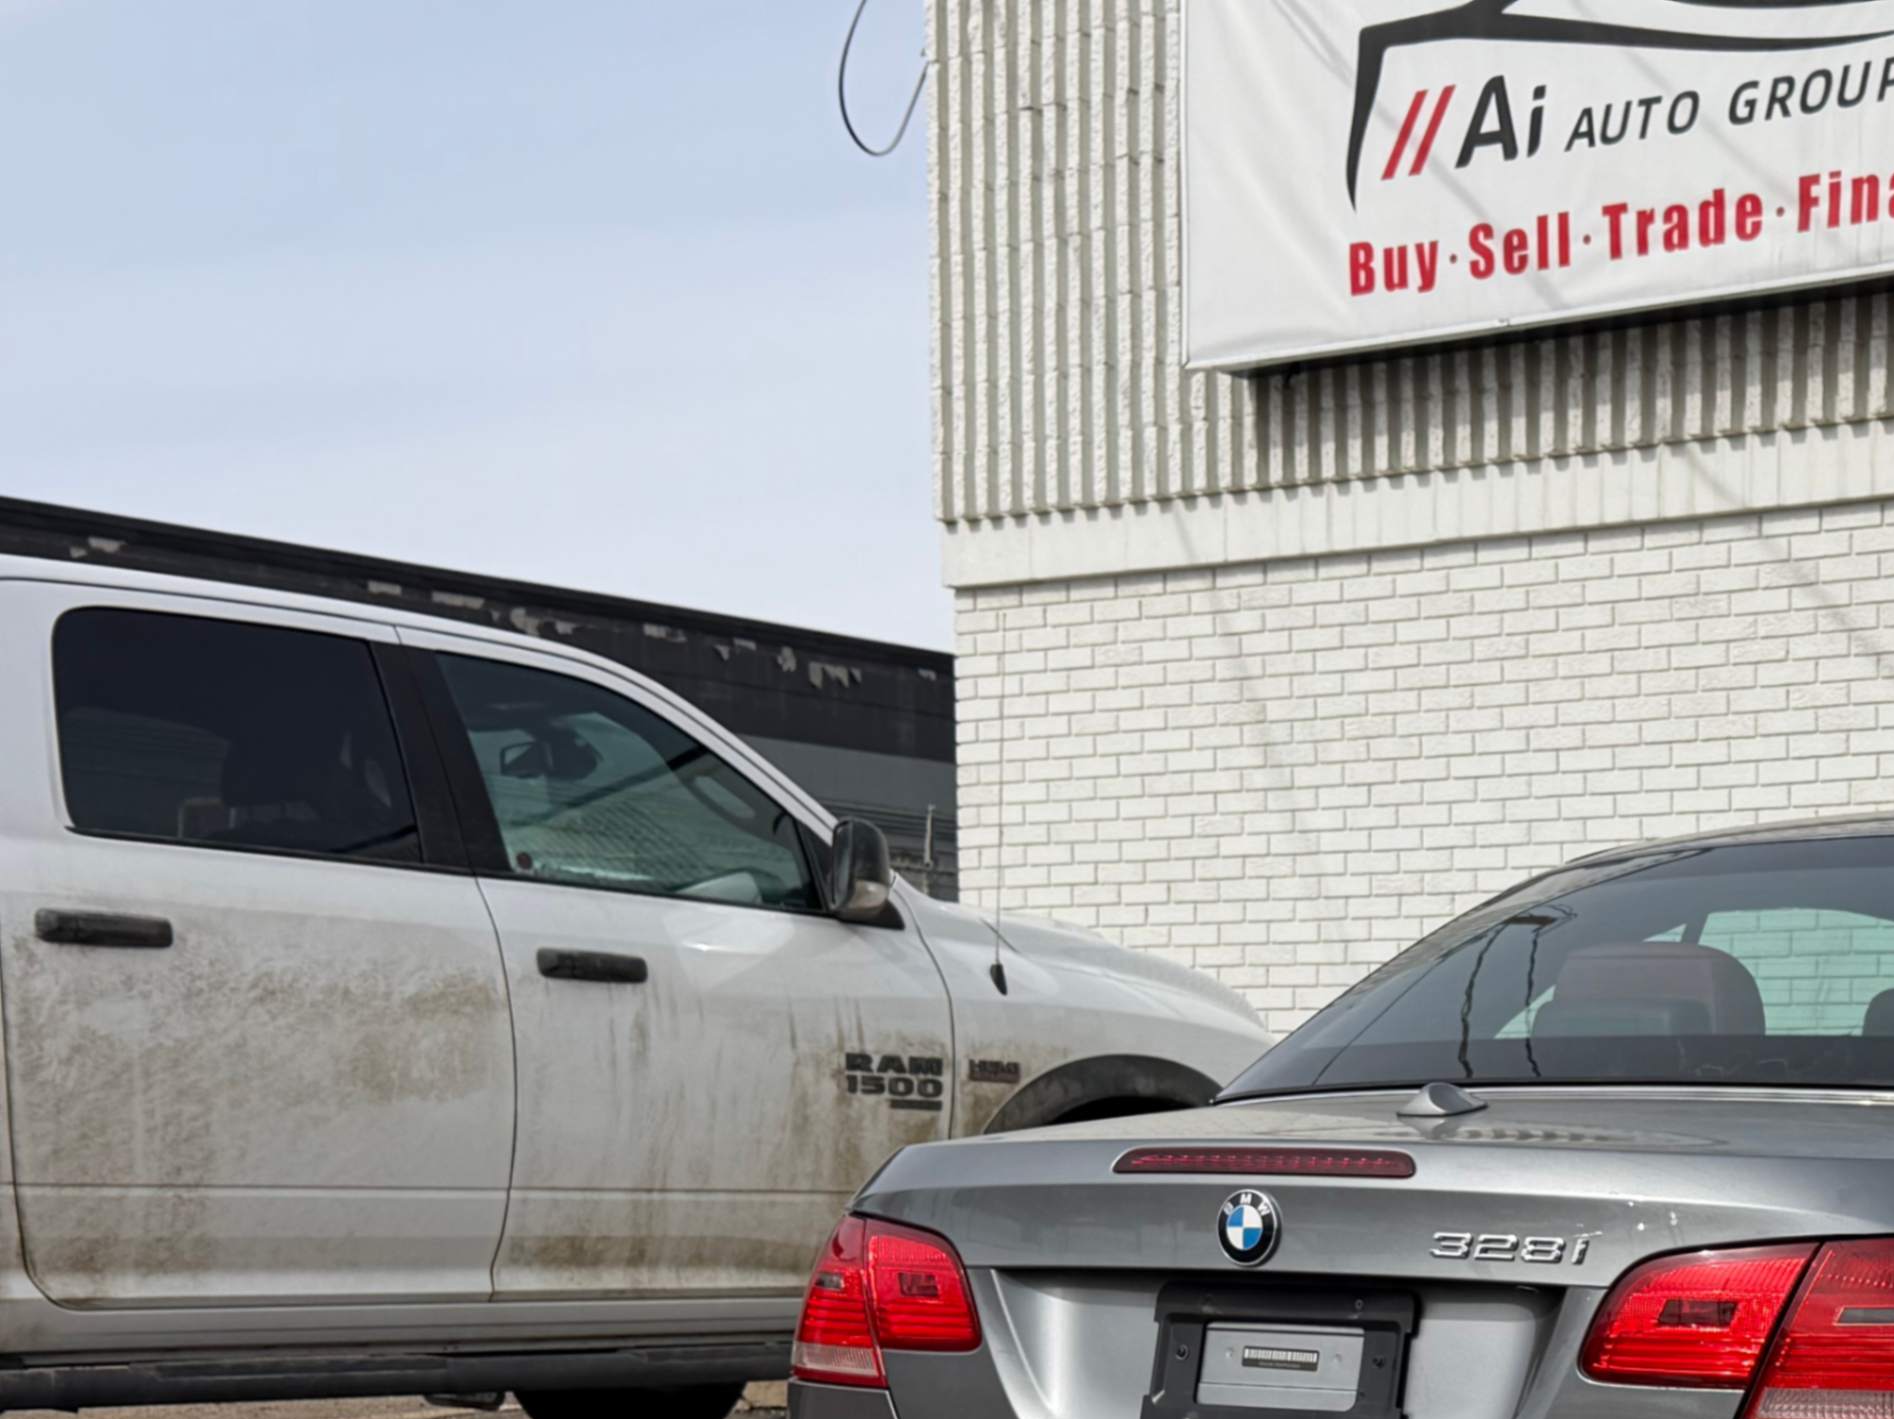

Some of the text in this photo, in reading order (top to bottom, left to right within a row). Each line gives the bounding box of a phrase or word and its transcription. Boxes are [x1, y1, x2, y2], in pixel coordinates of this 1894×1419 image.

[1565, 92, 1699, 151] AUTO
[845, 1052, 943, 1077] RAM
[846, 1075, 943, 1099] 1500
[1431, 1232, 1590, 1265] 328i
